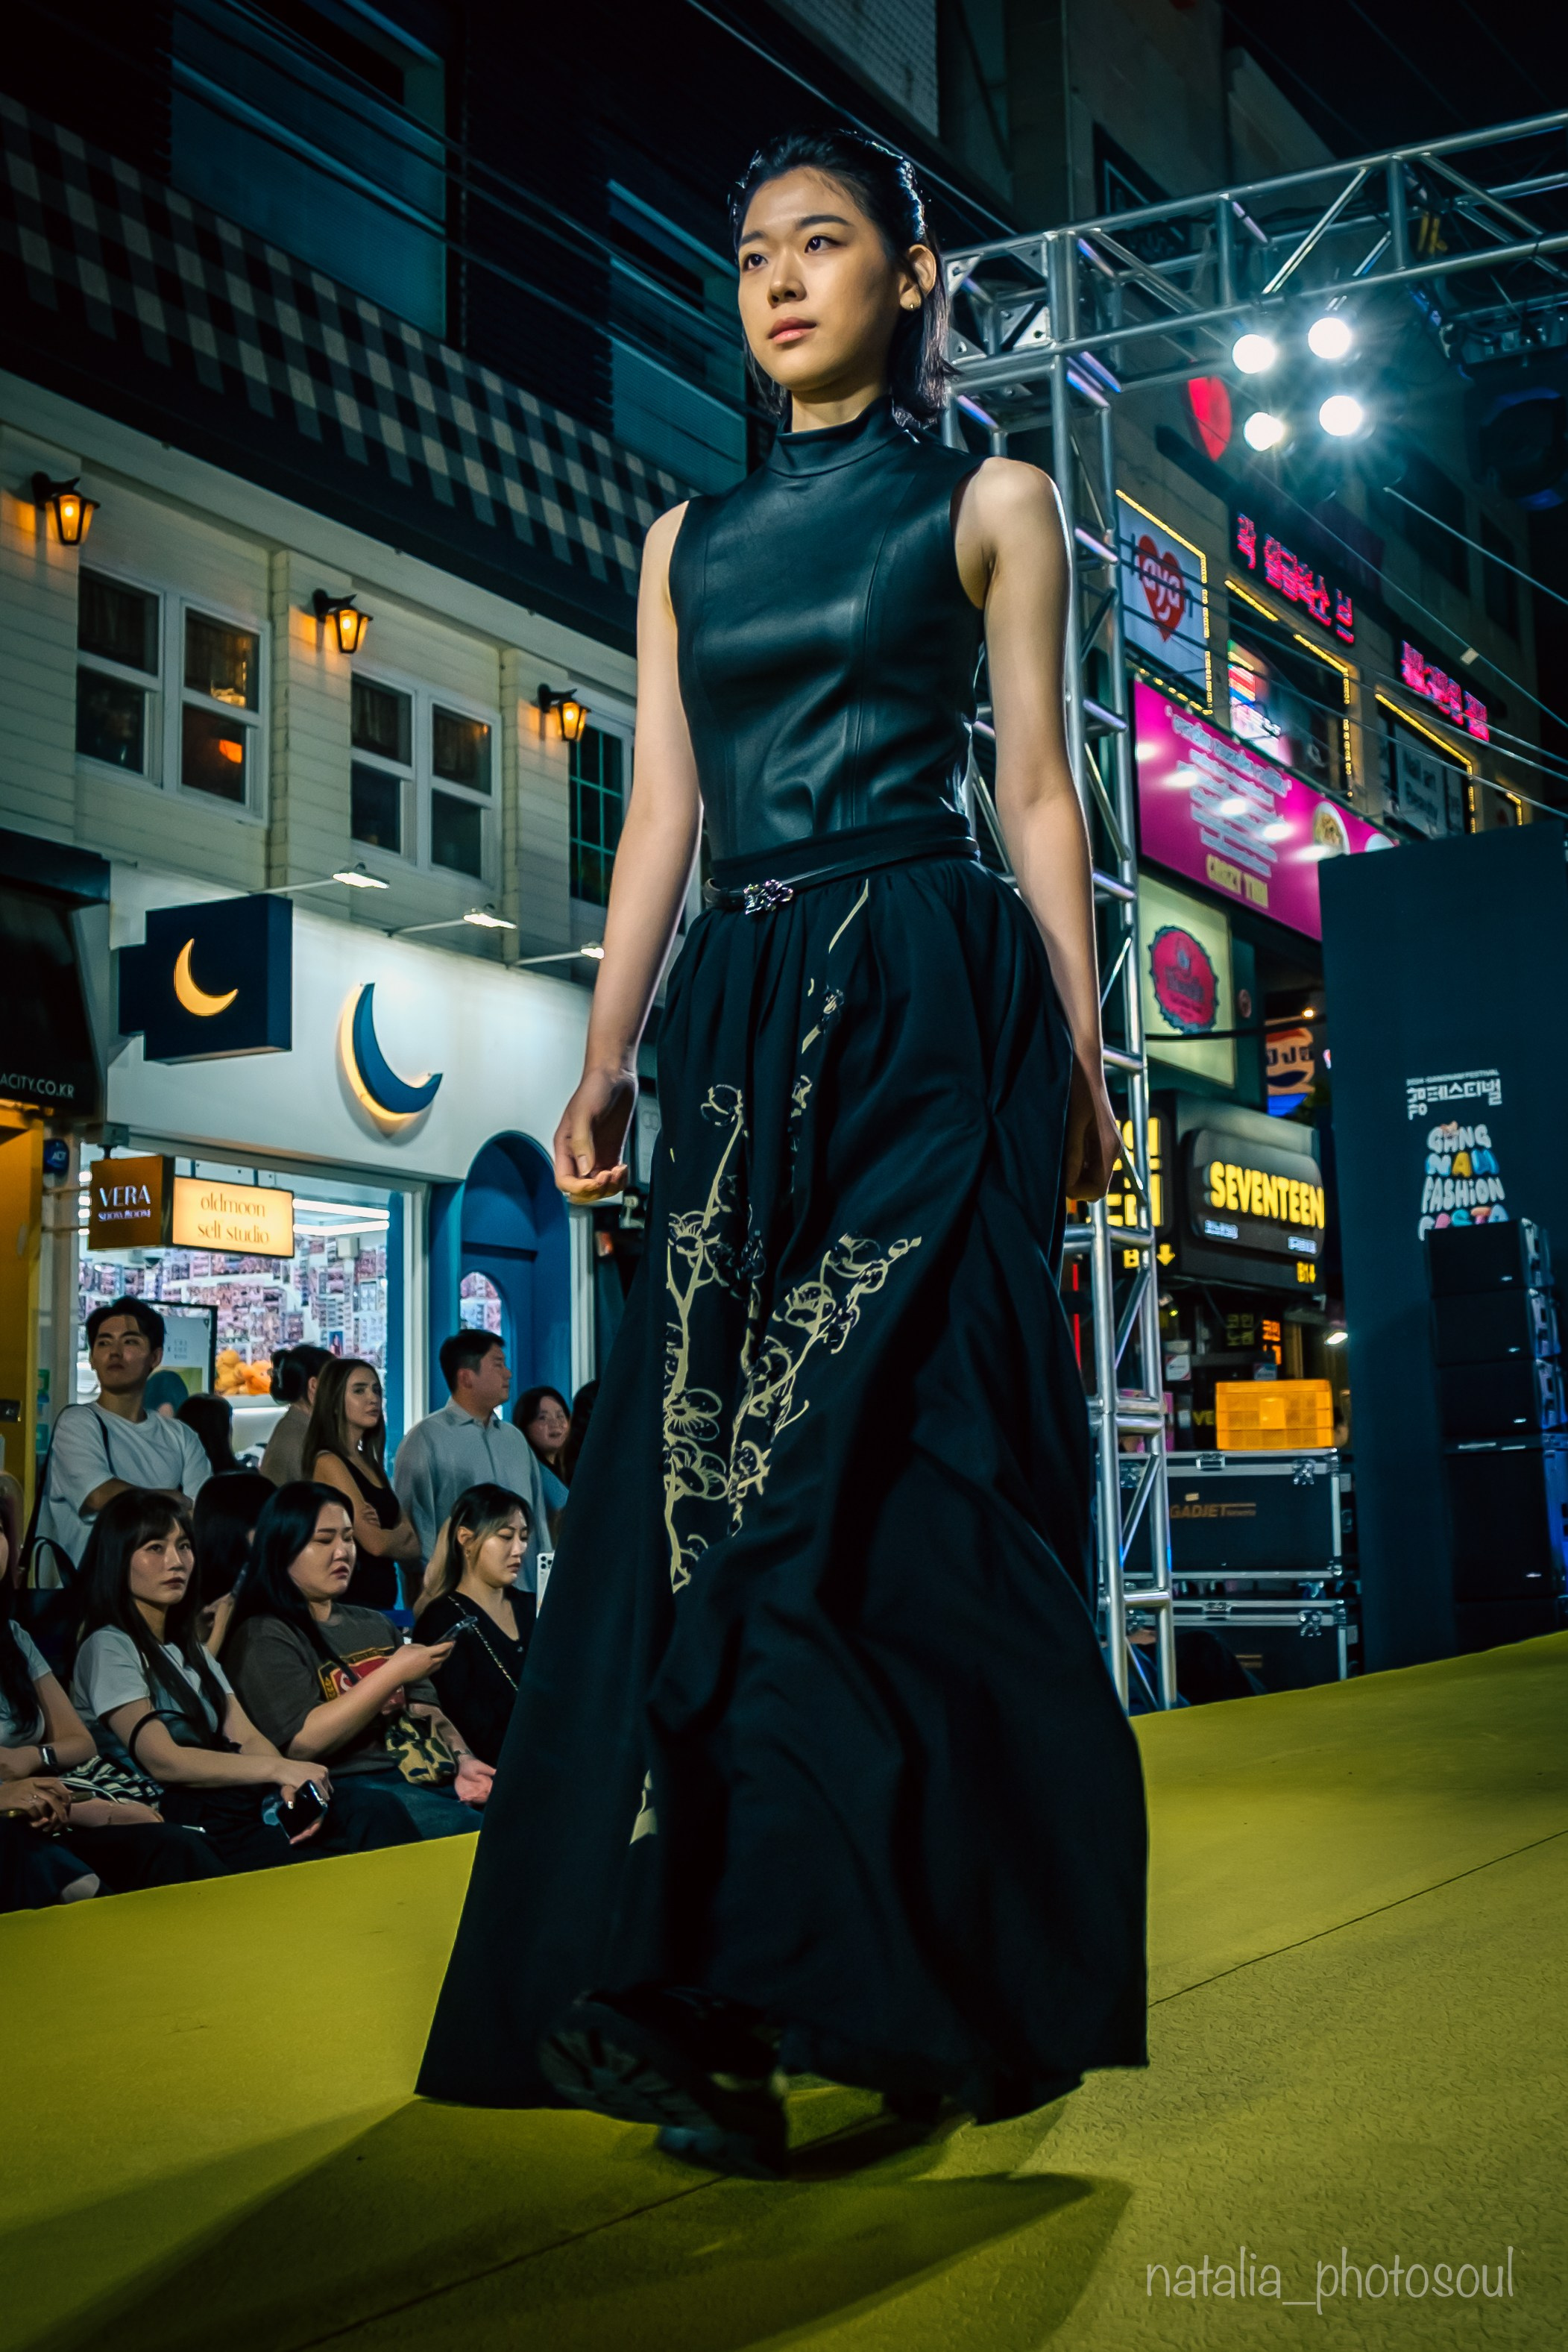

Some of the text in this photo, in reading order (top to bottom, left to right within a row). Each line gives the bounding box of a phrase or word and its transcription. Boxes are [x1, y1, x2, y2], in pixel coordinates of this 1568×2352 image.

[1426, 1123, 1491, 1154] GANG
[1425, 1148, 1500, 1177] NAM
[99, 1184, 151, 1207] VERA
[201, 1192, 265, 1218] oldmoon
[1209, 1161, 1325, 1230] SEVENTEEN
[226, 1226, 270, 1245] studio
